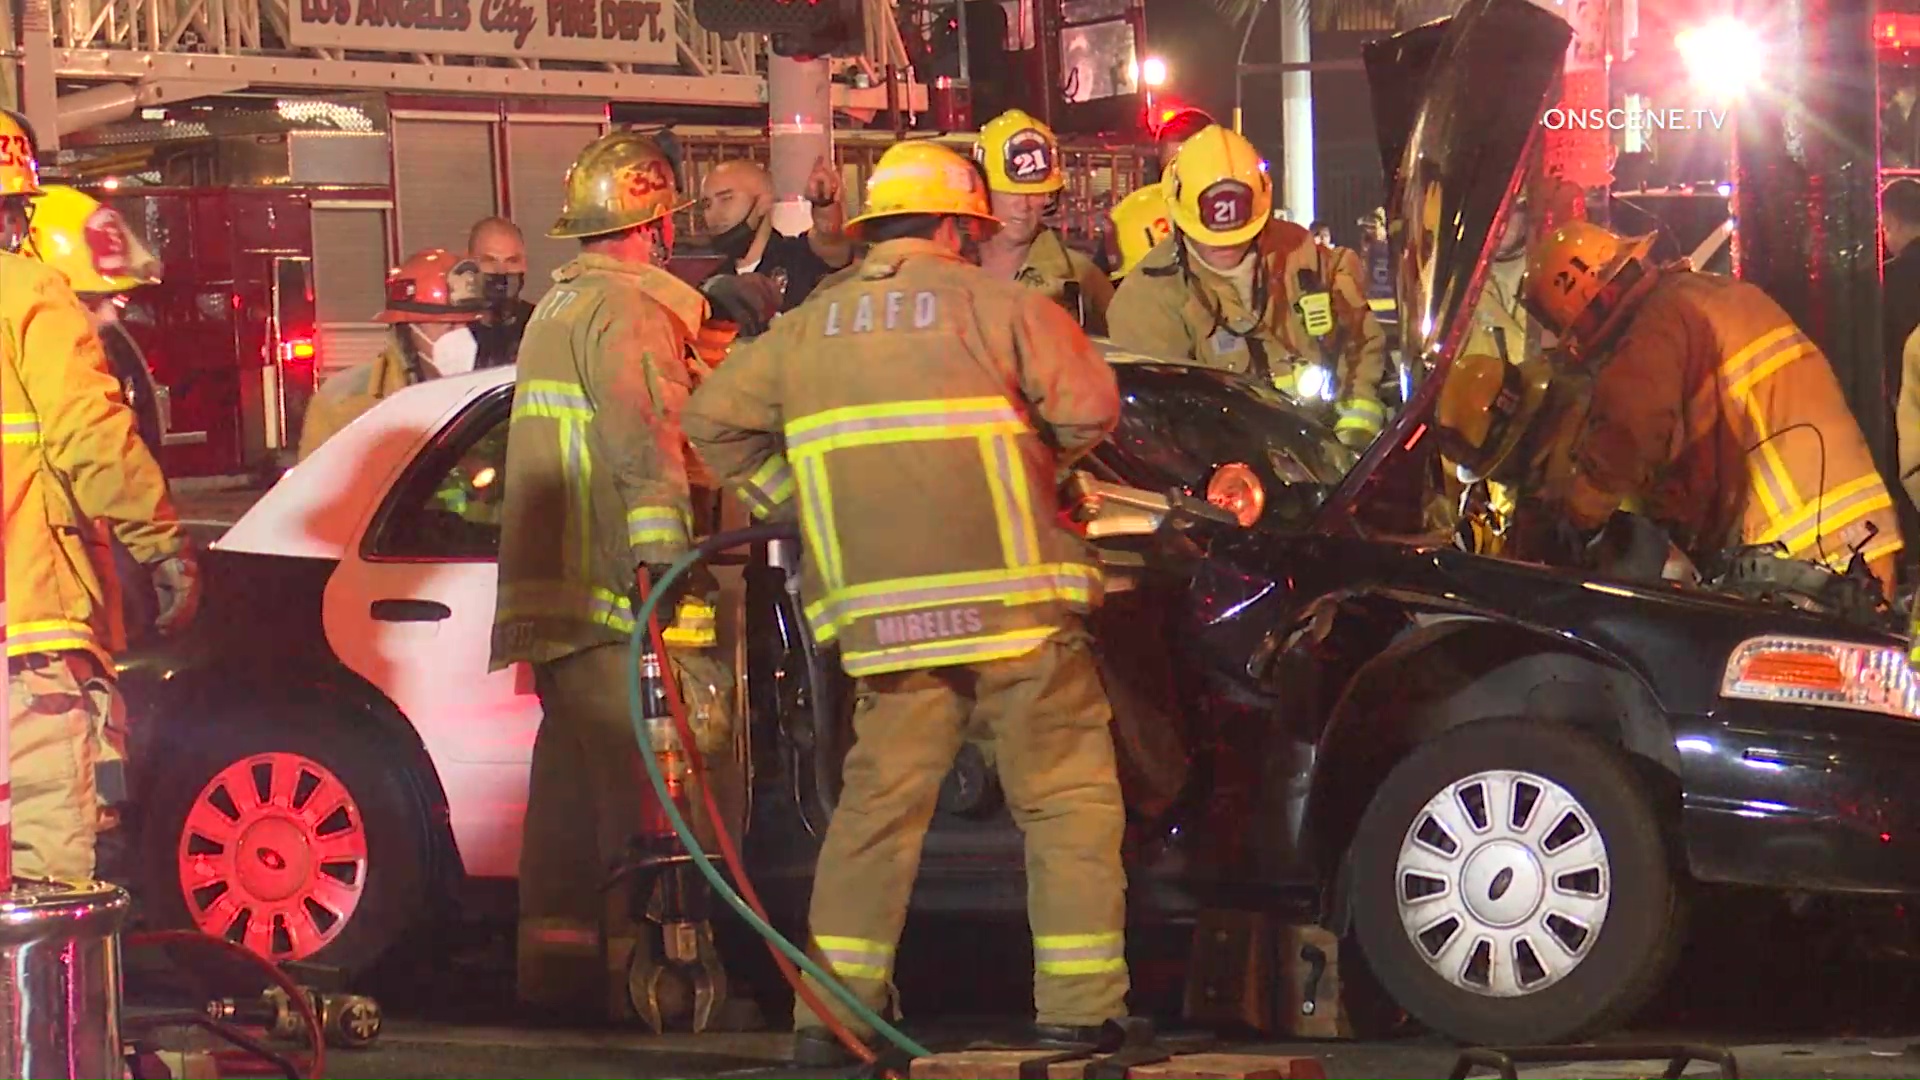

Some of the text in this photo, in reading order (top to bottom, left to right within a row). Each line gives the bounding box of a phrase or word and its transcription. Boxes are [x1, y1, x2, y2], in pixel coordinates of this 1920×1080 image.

[301, 0, 665, 49] LOS ANGELES City FIRE DEPT.
[1012, 148, 1047, 176] 21
[1213, 200, 1237, 222] 21
[1553, 255, 1590, 296] 21
[824, 291, 936, 336] LAFD
